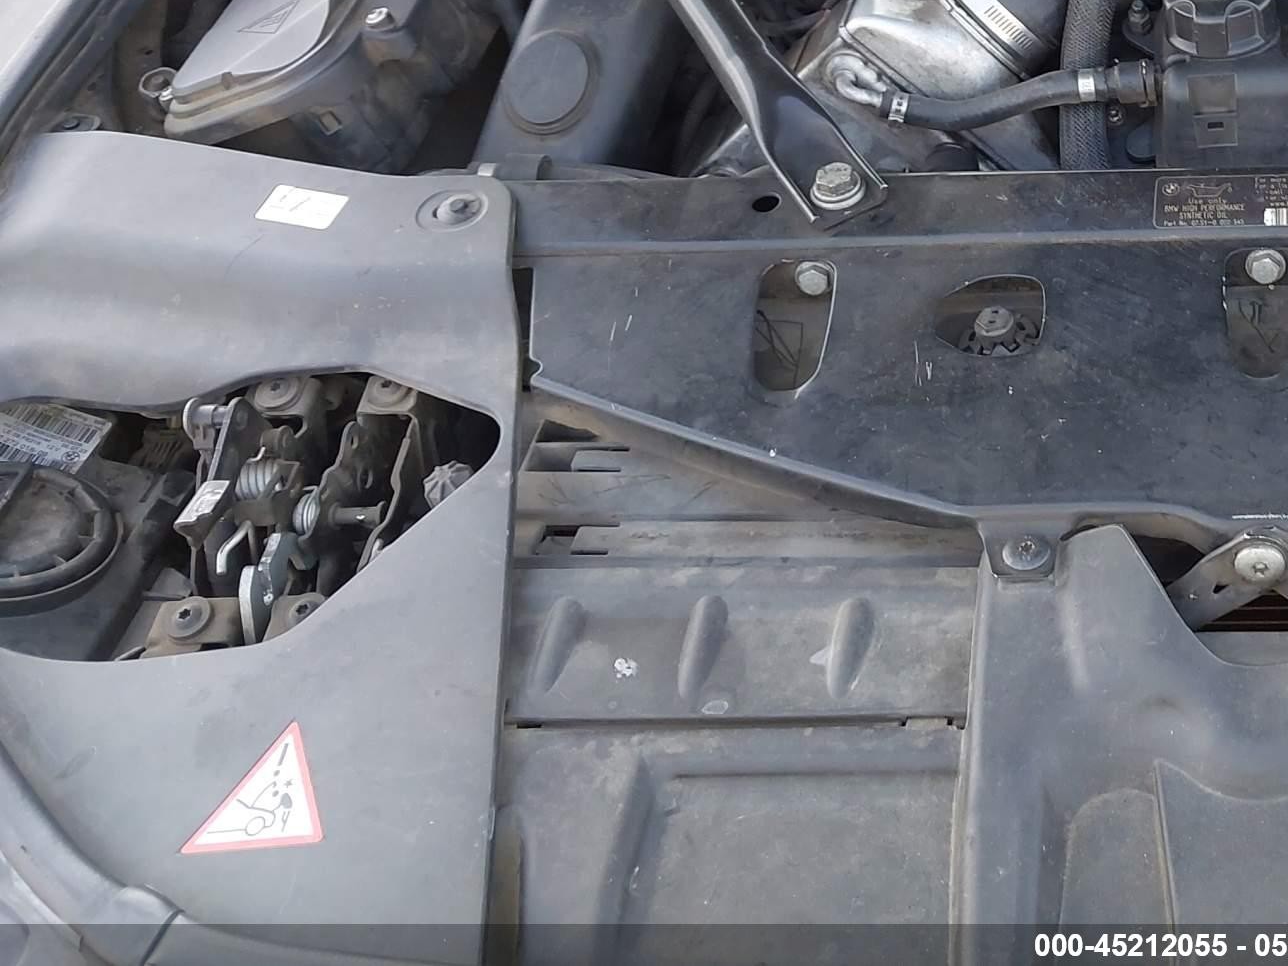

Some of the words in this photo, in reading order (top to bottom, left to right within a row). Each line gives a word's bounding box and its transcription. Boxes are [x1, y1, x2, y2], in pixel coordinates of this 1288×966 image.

[1182, 204, 1198, 212] HIGH
[1200, 203, 1245, 211] PERFORMANCE
[1179, 211, 1214, 219] SYNTHETIC
